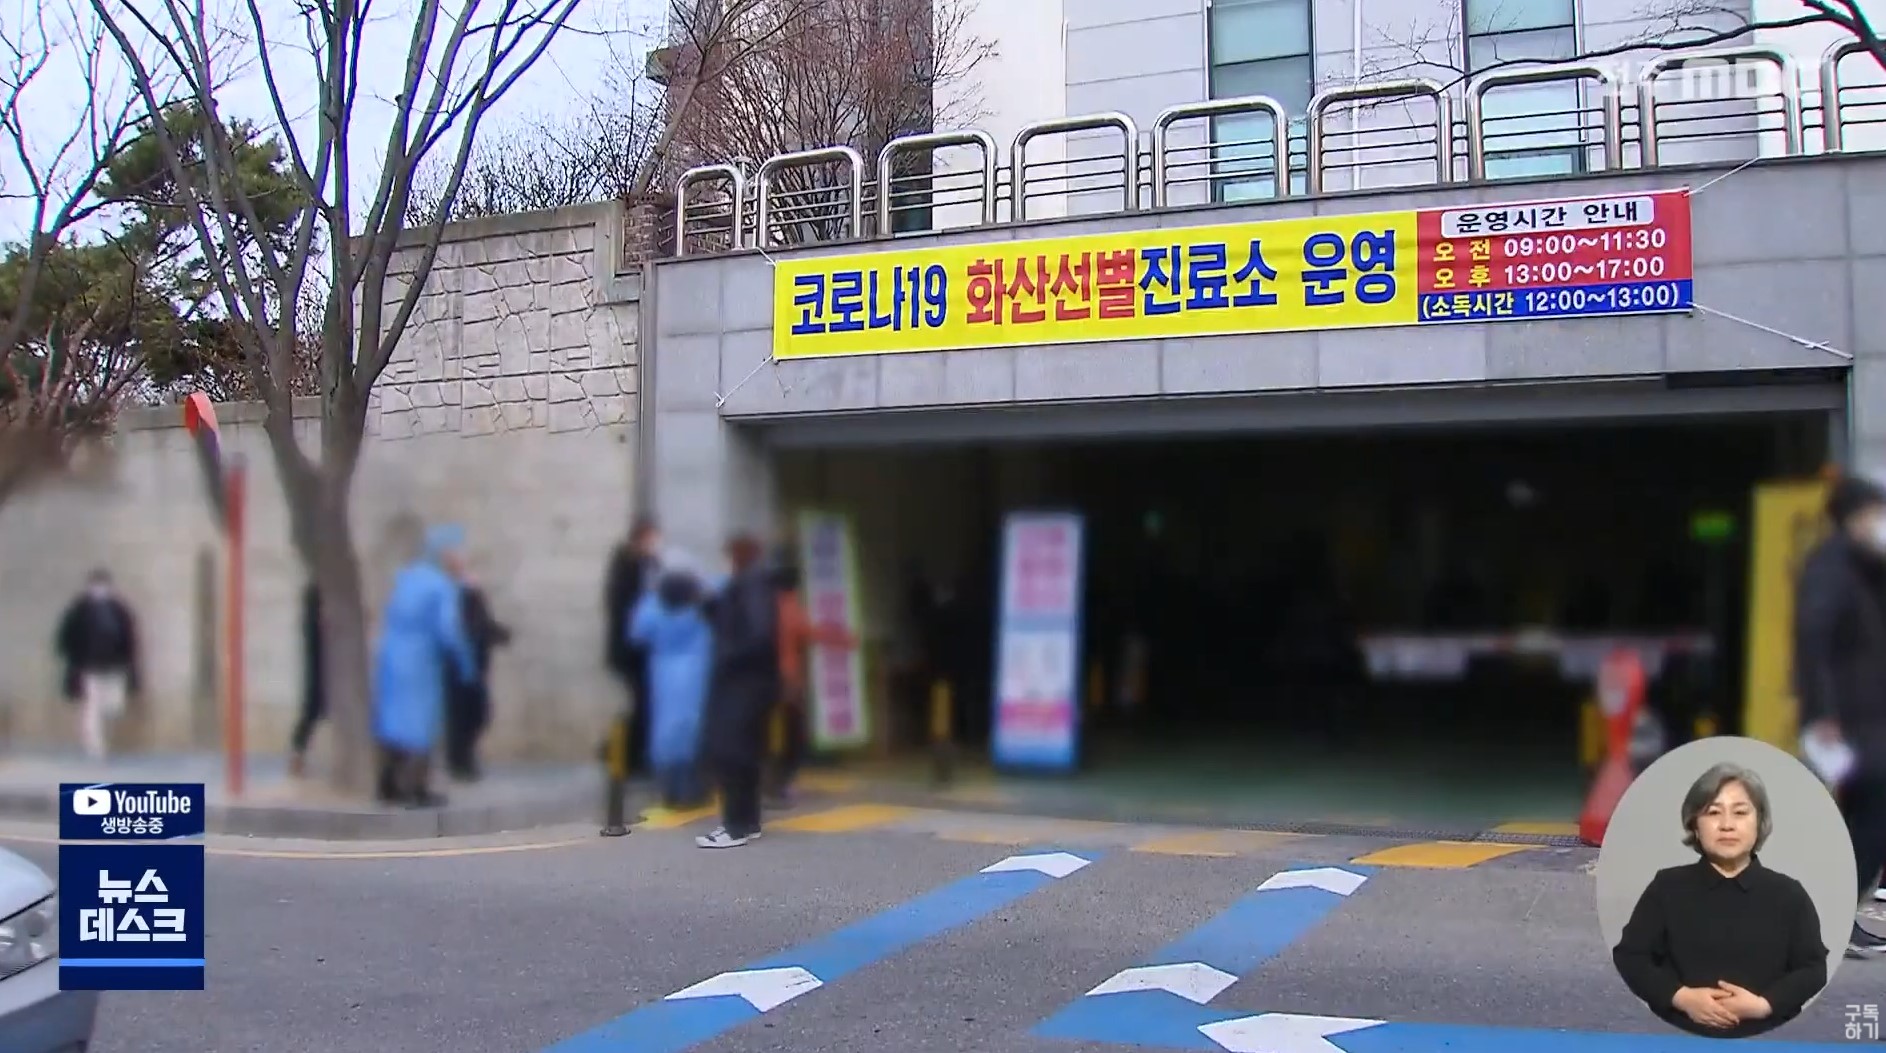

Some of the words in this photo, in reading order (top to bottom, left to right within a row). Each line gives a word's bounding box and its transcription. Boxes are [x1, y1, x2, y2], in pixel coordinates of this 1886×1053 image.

[1456, 204, 1568, 234] 운영시간
[1583, 199, 1638, 224] 안내
[1432, 241, 1456, 262] 오
[1468, 237, 1492, 262] 전
[1503, 228, 1667, 258] 09:00~11:30
[791, 263, 948, 336] 코로나19
[966, 239, 1278, 326] 화산선별진료소
[1301, 228, 1397, 307] 운영
[1432, 267, 1456, 289] 오
[1468, 264, 1492, 288] 후
[1503, 256, 1665, 285] 13:00~17:00
[1422, 290, 1515, 320] (소독시간
[1525, 282, 1679, 313] 12:00~13:00)
